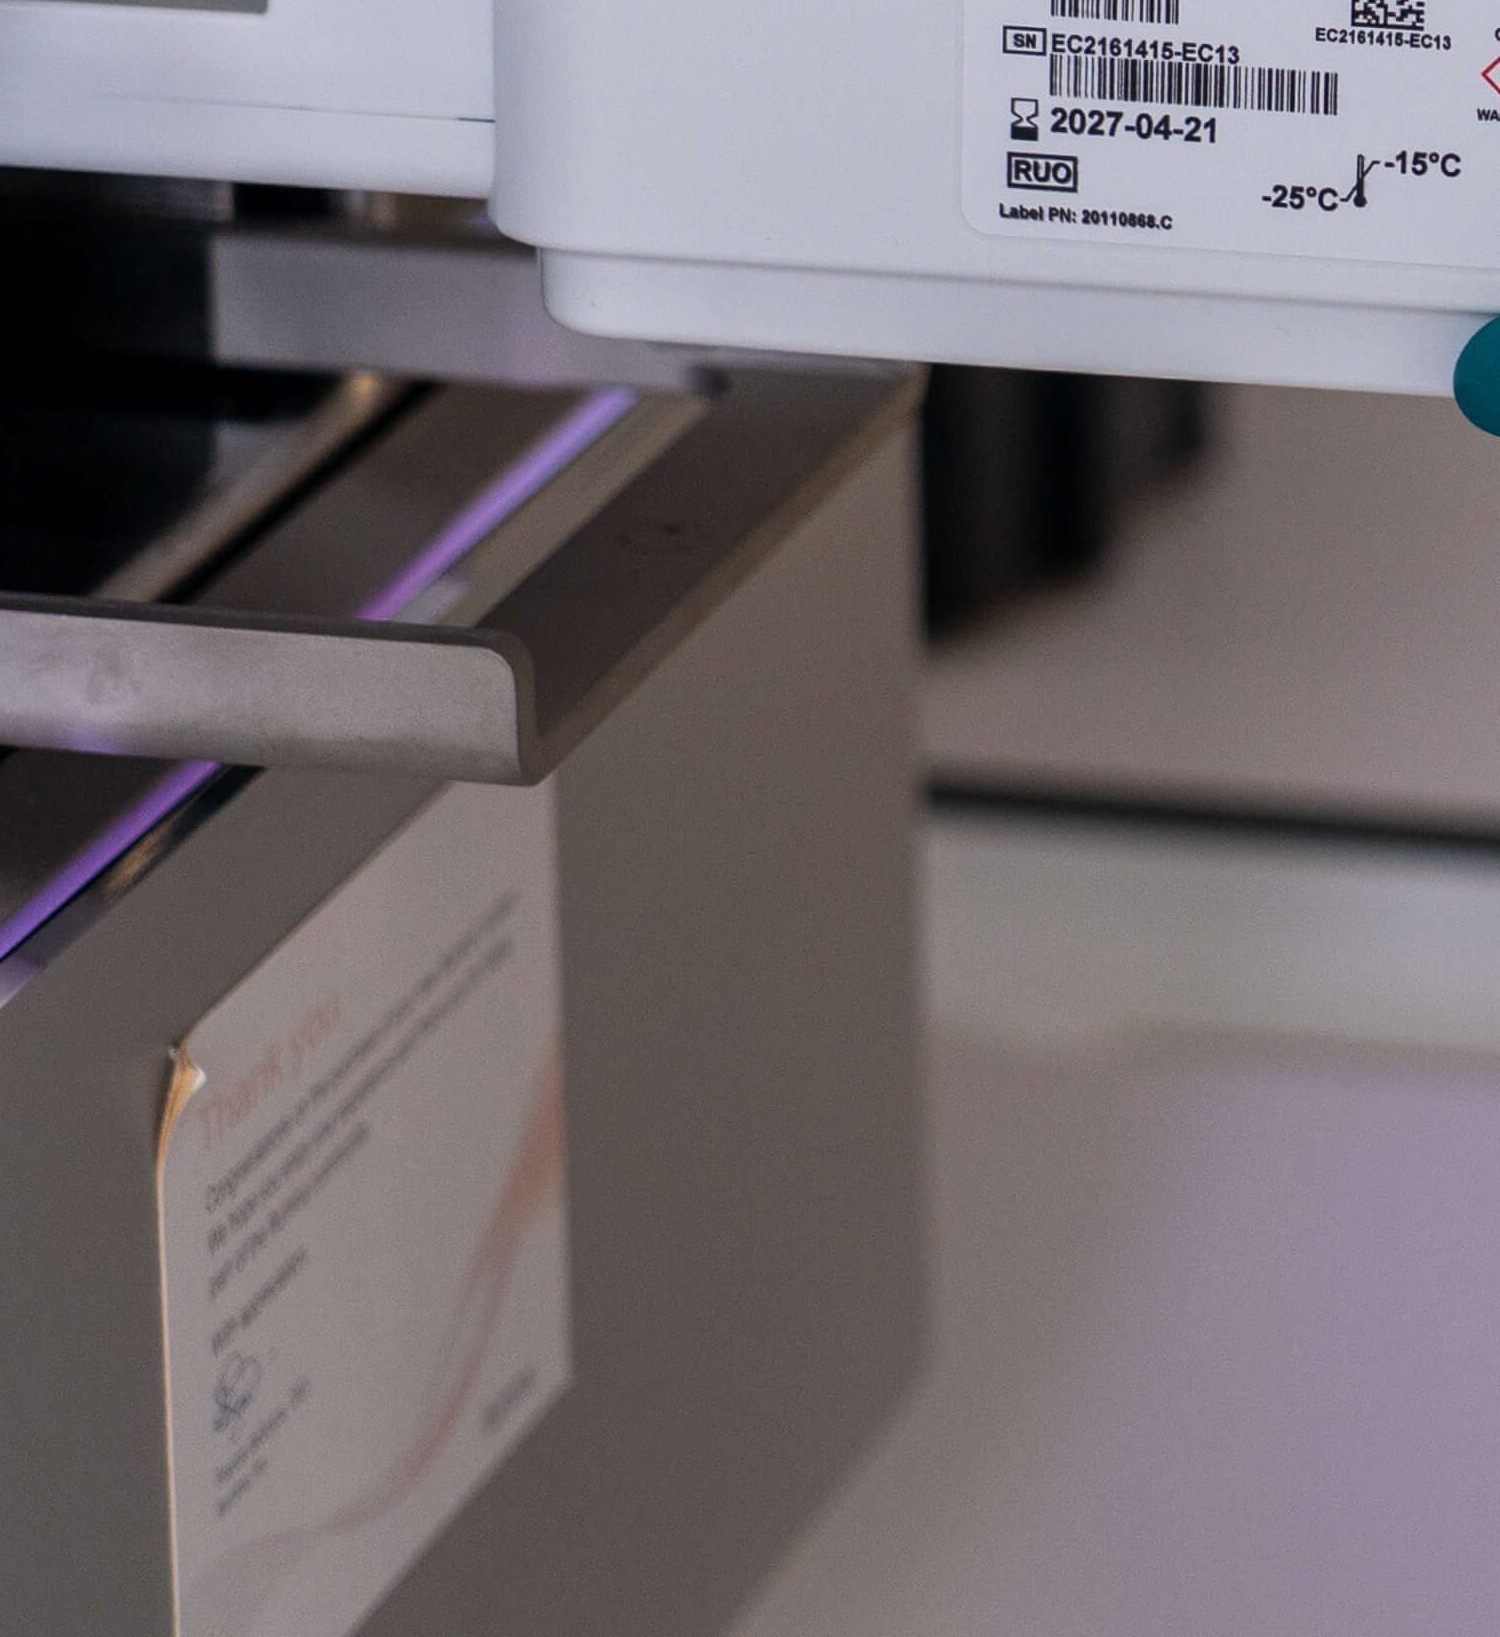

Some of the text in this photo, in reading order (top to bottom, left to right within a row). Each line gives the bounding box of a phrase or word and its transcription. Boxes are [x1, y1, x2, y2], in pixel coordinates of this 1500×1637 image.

[1007, 32, 1240, 64] SN EC2161415-EC13
[1315, 26, 1451, 51] EC2161415-EC13
[1049, 106, 1216, 144] 2027-04-21
[1011, 156, 1073, 188] RUO
[998, 202, 1045, 222] Label
[1047, 206, 1077, 224] PN:
[200, 1044, 280, 1149] Thank
